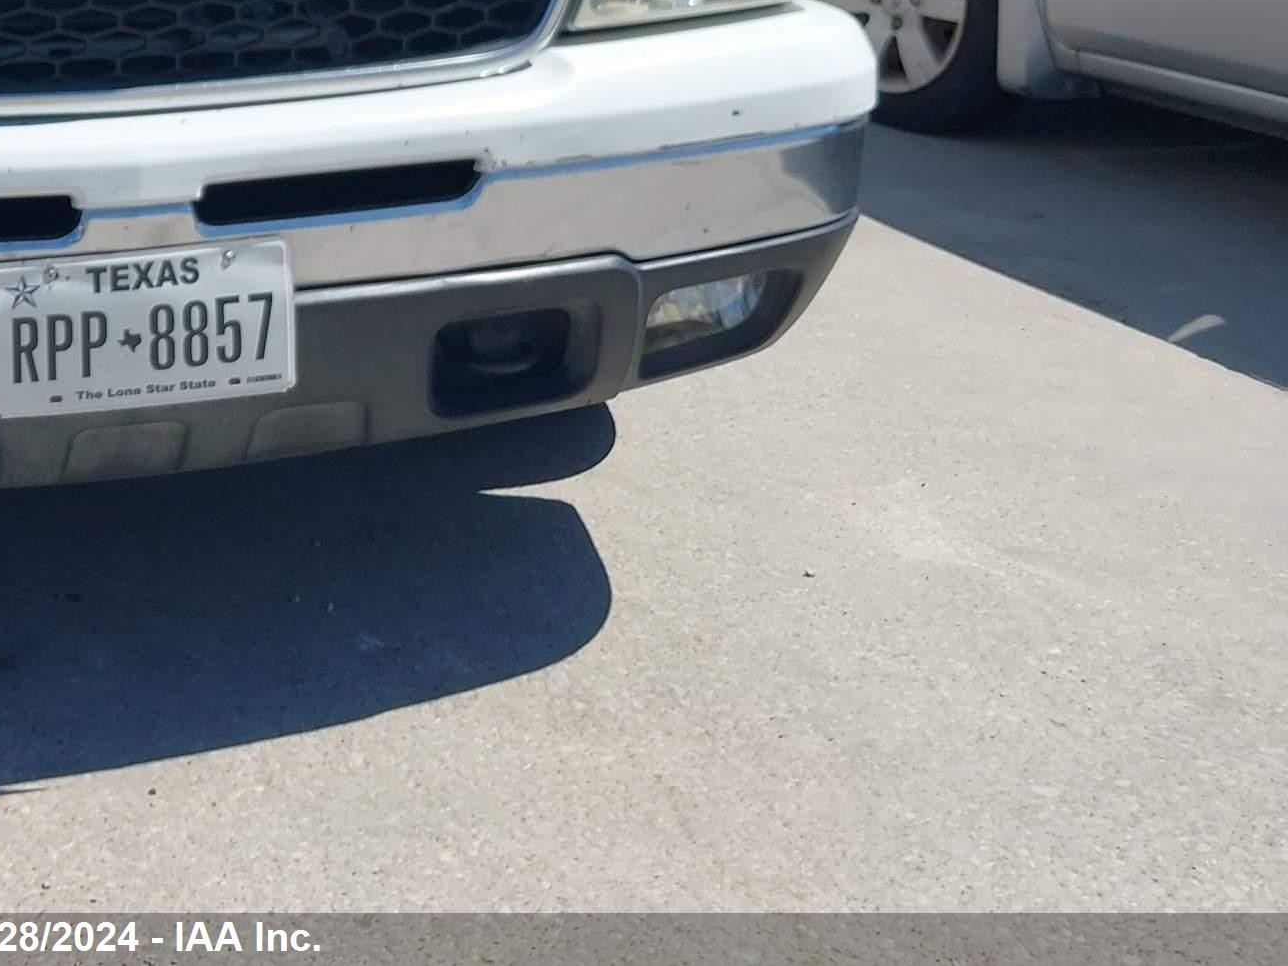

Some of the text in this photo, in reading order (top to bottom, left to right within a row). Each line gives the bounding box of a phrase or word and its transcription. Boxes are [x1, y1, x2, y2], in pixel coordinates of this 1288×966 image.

[85, 257, 201, 294] TEXAS
[11, 291, 274, 384] RPP 8857
[76, 377, 217, 401] The Lone Star State
